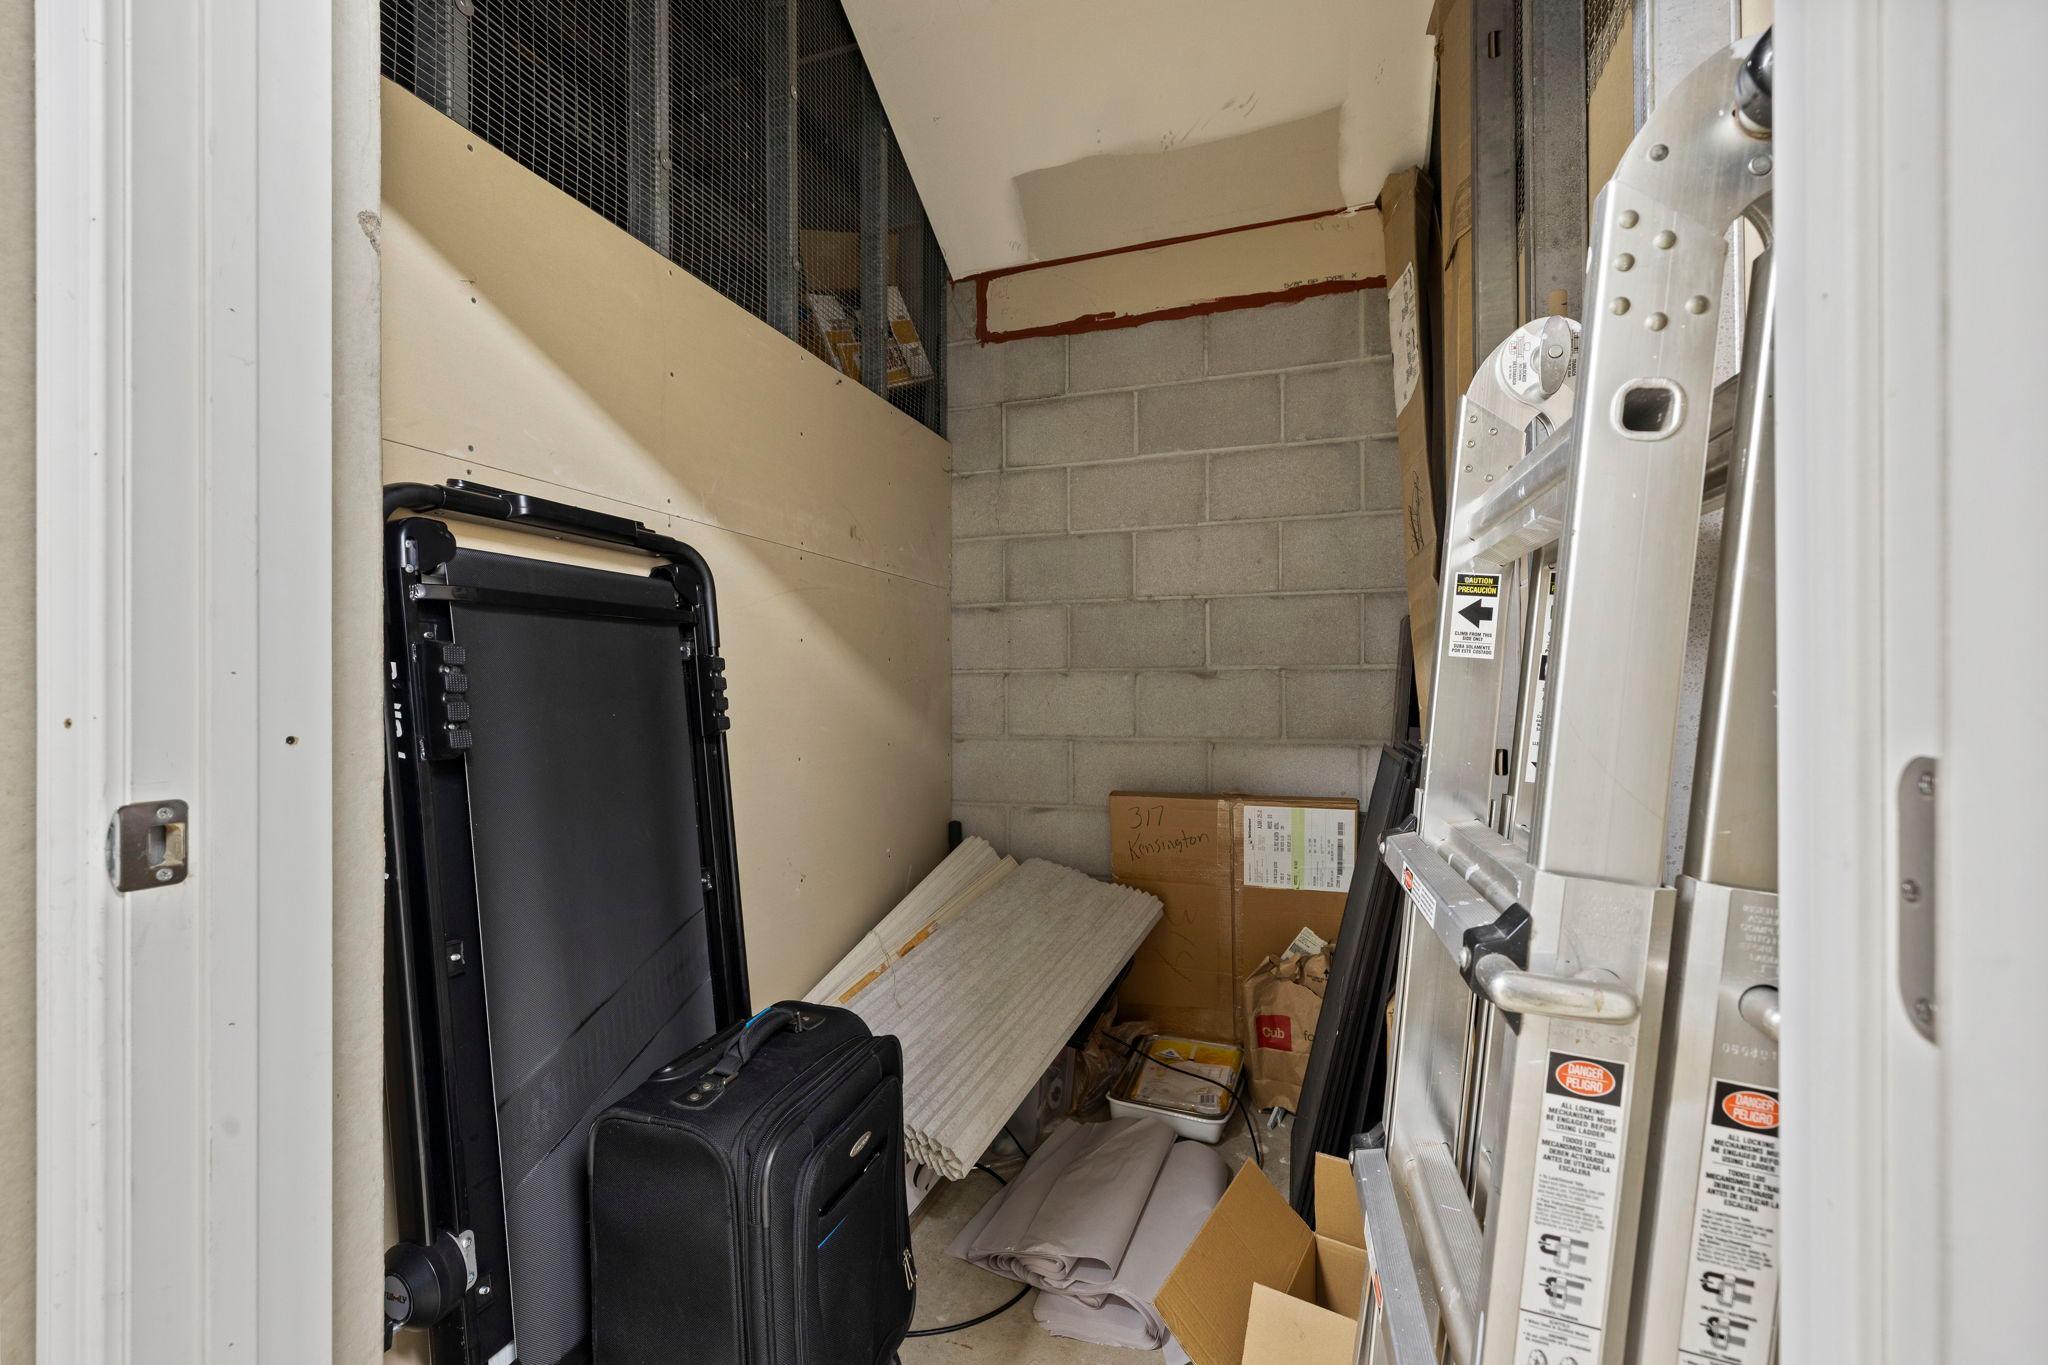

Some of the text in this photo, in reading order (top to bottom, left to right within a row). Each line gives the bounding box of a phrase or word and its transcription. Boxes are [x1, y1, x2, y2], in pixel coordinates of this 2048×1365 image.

[1458, 585, 1497, 594] PRECAUCIÓN
[1128, 805, 1164, 829] 317
[1262, 1027, 1314, 1042] Cub fo
[1568, 1063, 1603, 1079] DANGER
[1566, 1077, 1603, 1092] PELIGRO
[1575, 1105, 1604, 1115] LOCKING
[1736, 1094, 1775, 1111] DANGER
[1548, 1107, 1616, 1125] MECHANISMS MUST
[1733, 1107, 1773, 1125] PELIGRO
[1556, 1124, 1605, 1138] USING LADDER
[1557, 1116, 1588, 1127] ENGAGED
[1591, 1123, 1616, 1133] BEFORE
[1542, 1139, 1582, 1153] MECANISMOS
[1562, 1136, 1582, 1145] TODOS
[1543, 1154, 1562, 1162] ANTES
